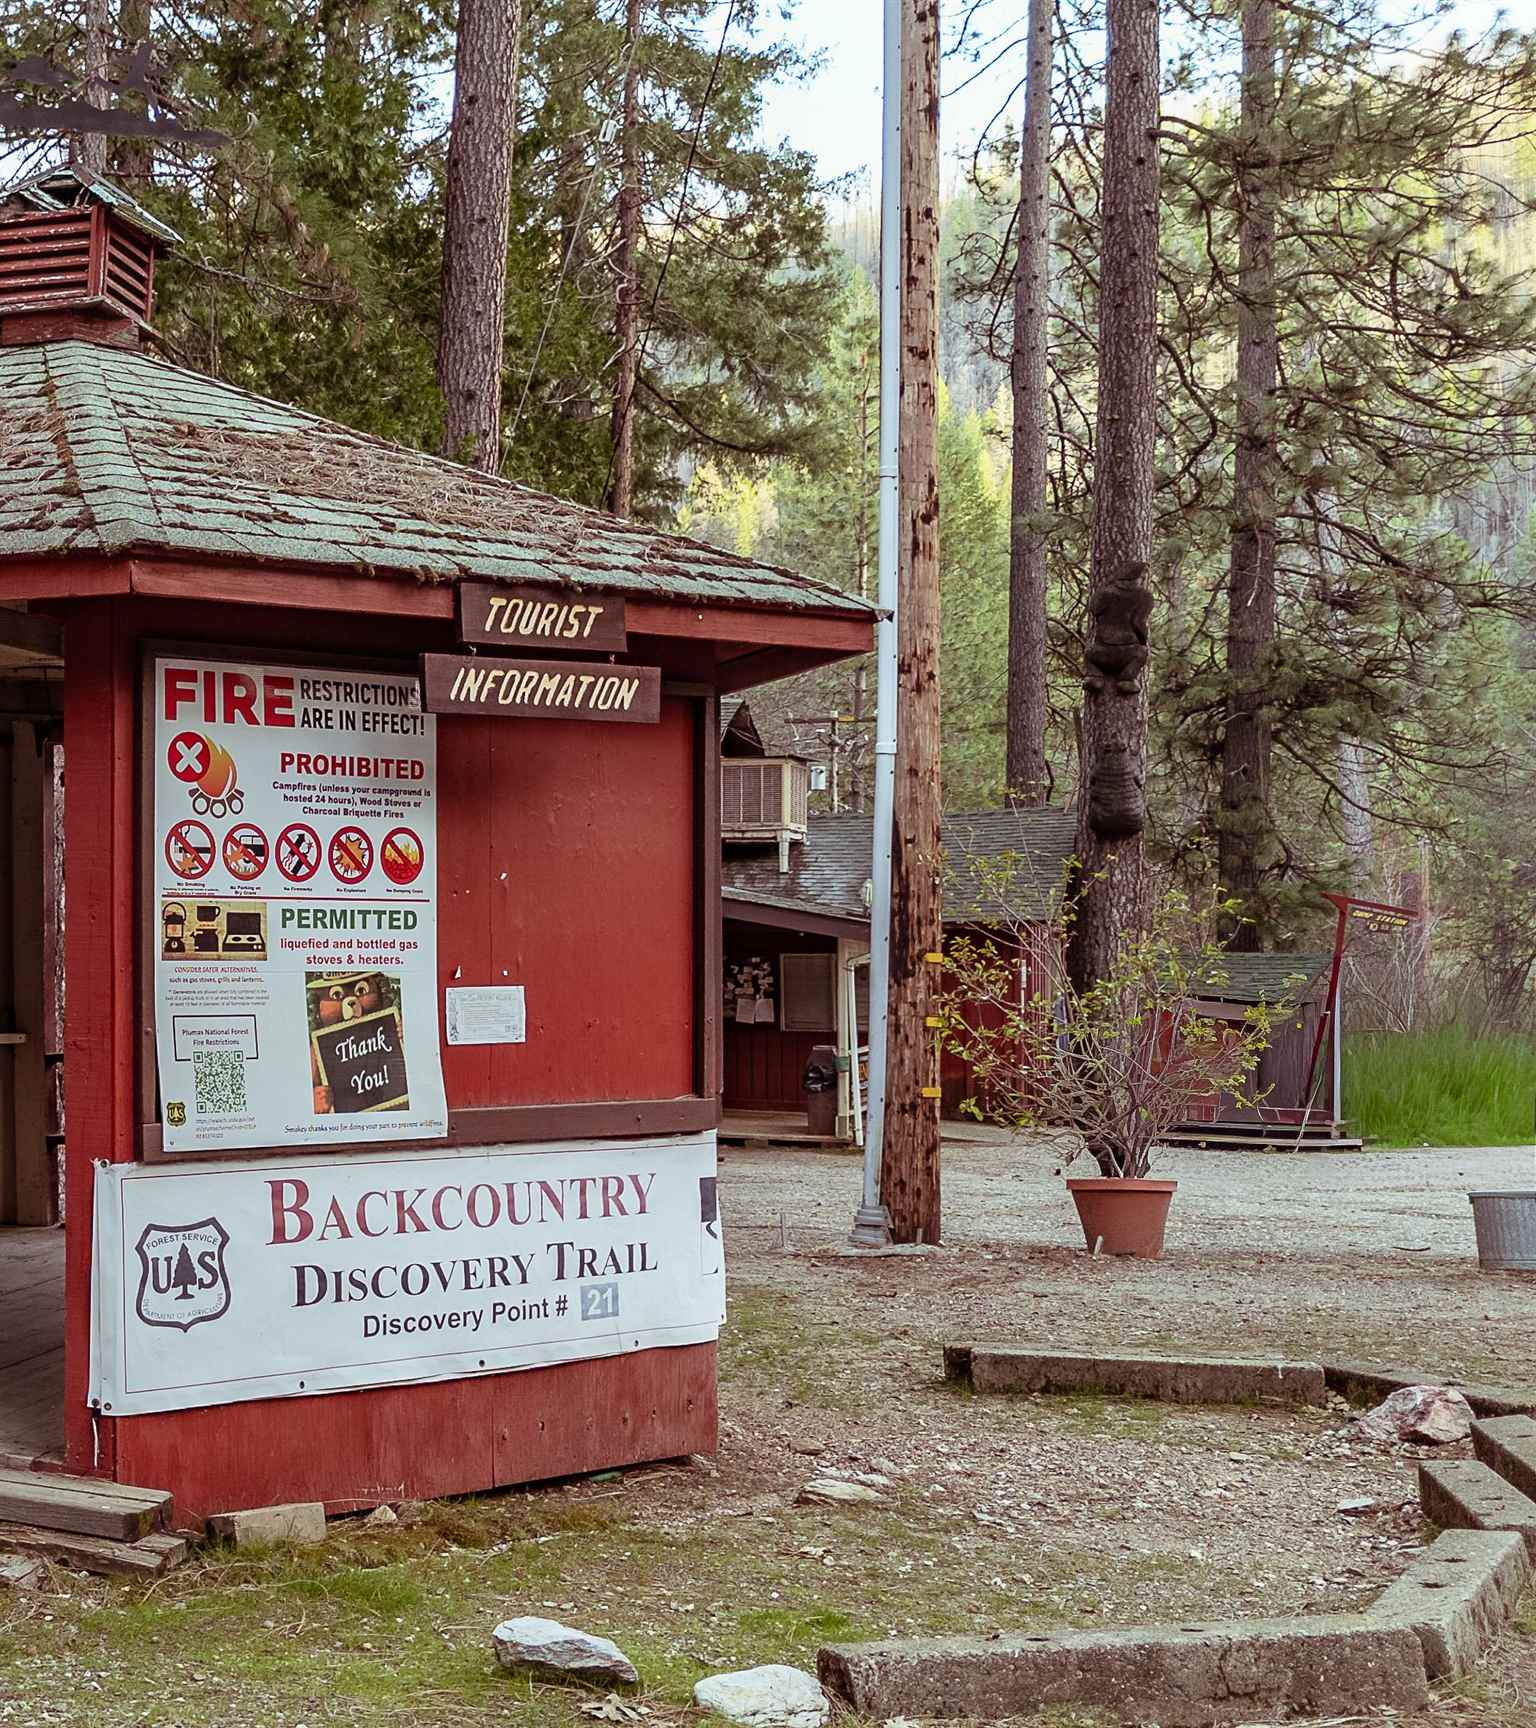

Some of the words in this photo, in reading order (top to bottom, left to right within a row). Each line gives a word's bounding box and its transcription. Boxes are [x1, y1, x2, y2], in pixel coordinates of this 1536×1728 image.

[484, 596, 605, 639] TOURIST
[164, 667, 296, 728] FIRE
[300, 678, 420, 708] RESTRICTIONS
[449, 666, 640, 711] INFORMATION
[300, 707, 334, 731] ARE
[339, 709, 356, 732] IN
[362, 711, 425, 736] EFFECT!
[280, 752, 425, 780] PROHIBITED
[272, 781, 317, 792] Campfires
[319, 783, 350, 793] (unless
[352, 785, 370, 795] your
[372, 787, 422, 797] campground
[424, 788, 431, 797] is
[283, 794, 313, 803] hosted
[315, 794, 326, 804] 24
[328, 795, 357, 806] hours),
[359, 797, 382, 806] Wood
[384, 798, 411, 807] Stoves
[302, 805, 341, 816] Charcoal
[343, 807, 382, 819] Briquette
[383, 809, 404, 819] Fires
[281, 907, 418, 930] PERMITTED
[280, 938, 329, 951] liquefied
[332, 939, 353, 949] and
[356, 939, 396, 950] bottled
[399, 940, 418, 951] gas
[306, 955, 343, 965] stoves
[346, 954, 354, 965] &
[358, 954, 404, 965] heaters.
[335, 1026, 392, 1063] Thank
[350, 1064, 390, 1094] You!
[284, 1124, 307, 1133] Smokey
[264, 1172, 657, 1247] BACKCOUNTRY
[146, 1234, 180, 1250] FOREST
[181, 1232, 219, 1246] SERVICE
[289, 1252, 537, 1309] DISCOVERY
[546, 1240, 659, 1283] TRAIL
[363, 1306, 484, 1338] Discovery
[491, 1297, 549, 1326] Point
[555, 1294, 569, 1318] #
[586, 1287, 616, 1317] 21
